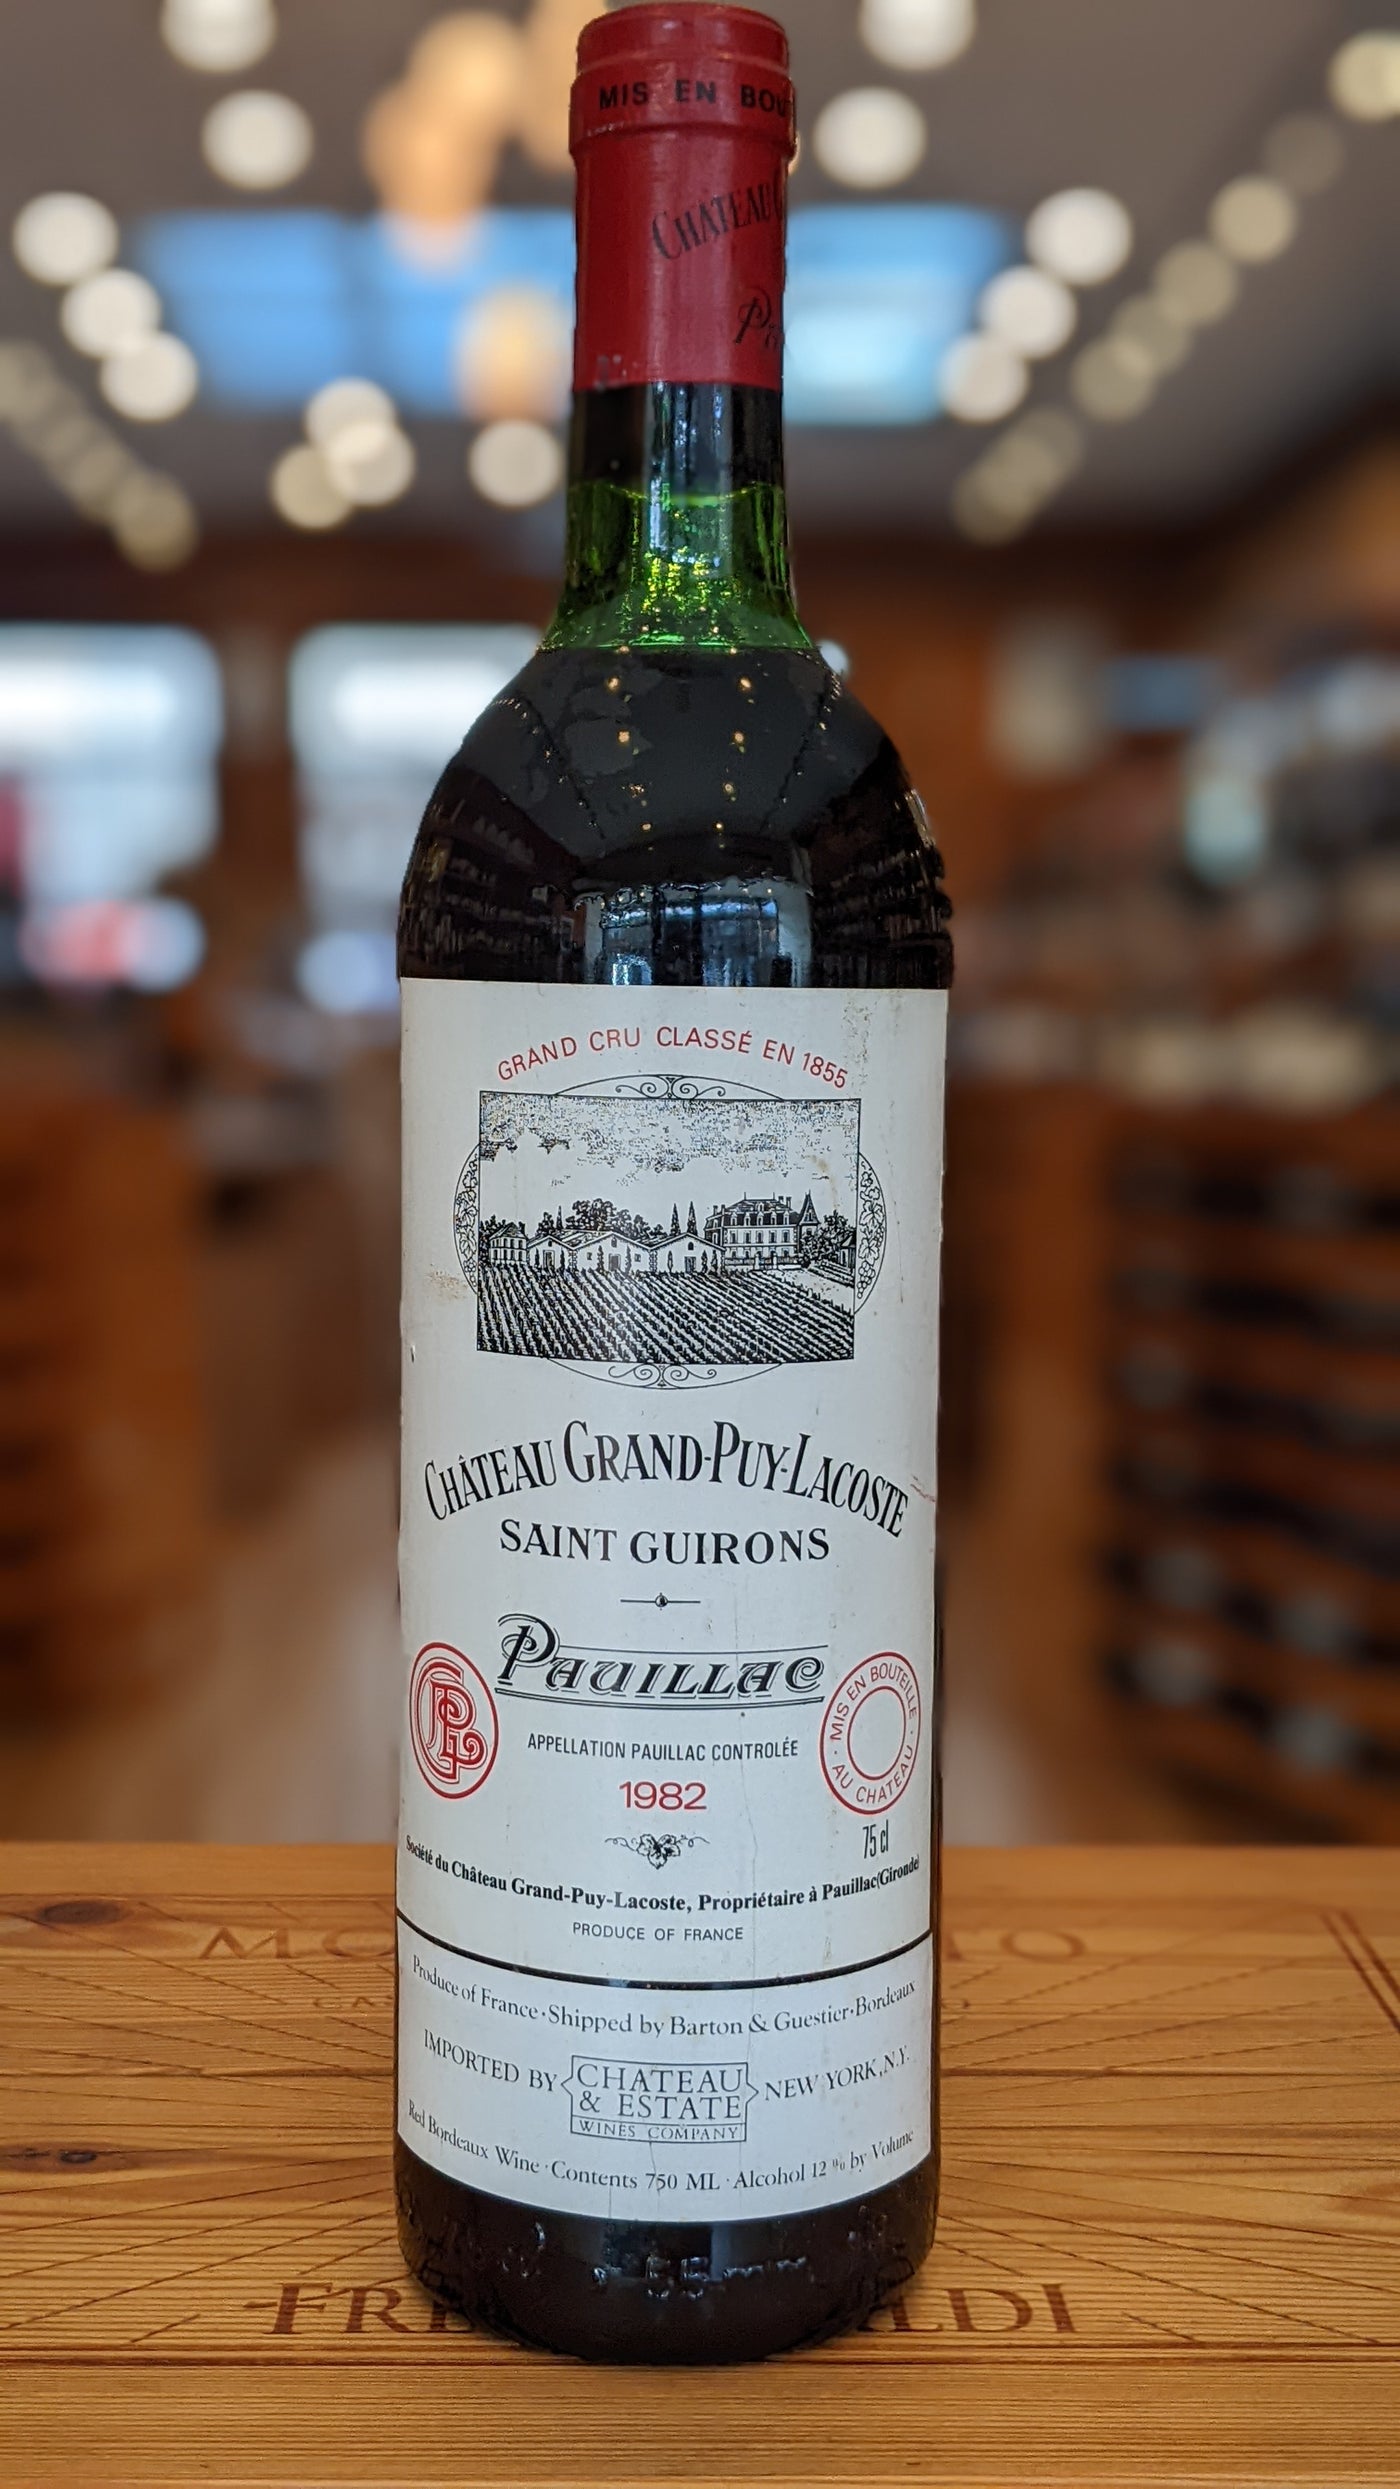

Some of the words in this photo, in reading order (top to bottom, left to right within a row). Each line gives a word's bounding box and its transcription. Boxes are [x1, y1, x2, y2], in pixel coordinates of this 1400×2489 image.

[599, 82, 648, 109] MIS
[675, 79, 716, 104] EN
[498, 1037, 577, 1081] GRAND
[590, 1027, 641, 1051] CRU
[657, 1026, 752, 1053] CLASSÉ
[762, 1039, 795, 1065] EN
[802, 1052, 848, 1089] 1855
[424, 1440, 558, 1521] CHÂTEAU
[500, 1519, 617, 1561] SAINT
[630, 1528, 830, 1565] GUIRONS
[830, 1702, 849, 1740] MIS
[846, 1675, 867, 1701] EN
[870, 1663, 917, 1719] BOUTEILLE
[527, 1732, 625, 1758] APPELLATION
[632, 1743, 706, 1761] PAUILLAC
[712, 1736, 798, 1761] CONTROLÉE
[619, 1781, 707, 1810] 1982
[832, 1763, 854, 1789] AU
[856, 1745, 913, 1804] CHATEAU
[862, 1823, 877, 1859] 75
[880, 1819, 889, 1852] cl
[406, 1835, 433, 1866] Société
[435, 1854, 449, 1873] du
[452, 1861, 506, 1891] Château
[698, 1889, 804, 1913] Propriétaire
[809, 1887, 818, 1903] à
[573, 1922, 645, 1940] PRODUCE
[655, 1928, 675, 1940] OF
[684, 1927, 743, 1940] FRANCE
[413, 1954, 459, 1997] Produce
[461, 1984, 477, 2003] of
[640, 2014, 664, 2038] by
[671, 2015, 743, 2036] Barton
[749, 2014, 770, 2033] &
[424, 2028, 519, 2084] IMPORTED
[529, 2068, 558, 2092] BY
[577, 2063, 743, 2094] CHATEAU
[579, 2090, 601, 2113] &
[618, 2093, 741, 2121] ESTATE
[765, 2075, 818, 2100] NEW
[409, 2099, 425, 2128] Red
[428, 2115, 488, 2159] Bordeaux
[495, 2145, 539, 2173] Wine
[552, 2160, 637, 2189] Contents
[646, 2173, 677, 2191] 750
[686, 2173, 720, 2190] ML
[733, 2164, 805, 2189] Alcohol
[850, 2151, 867, 2172] by
[872, 2130, 914, 2160] Volume
[579, 2119, 635, 2138] WINES
[648, 2126, 738, 2140] COMPANY
